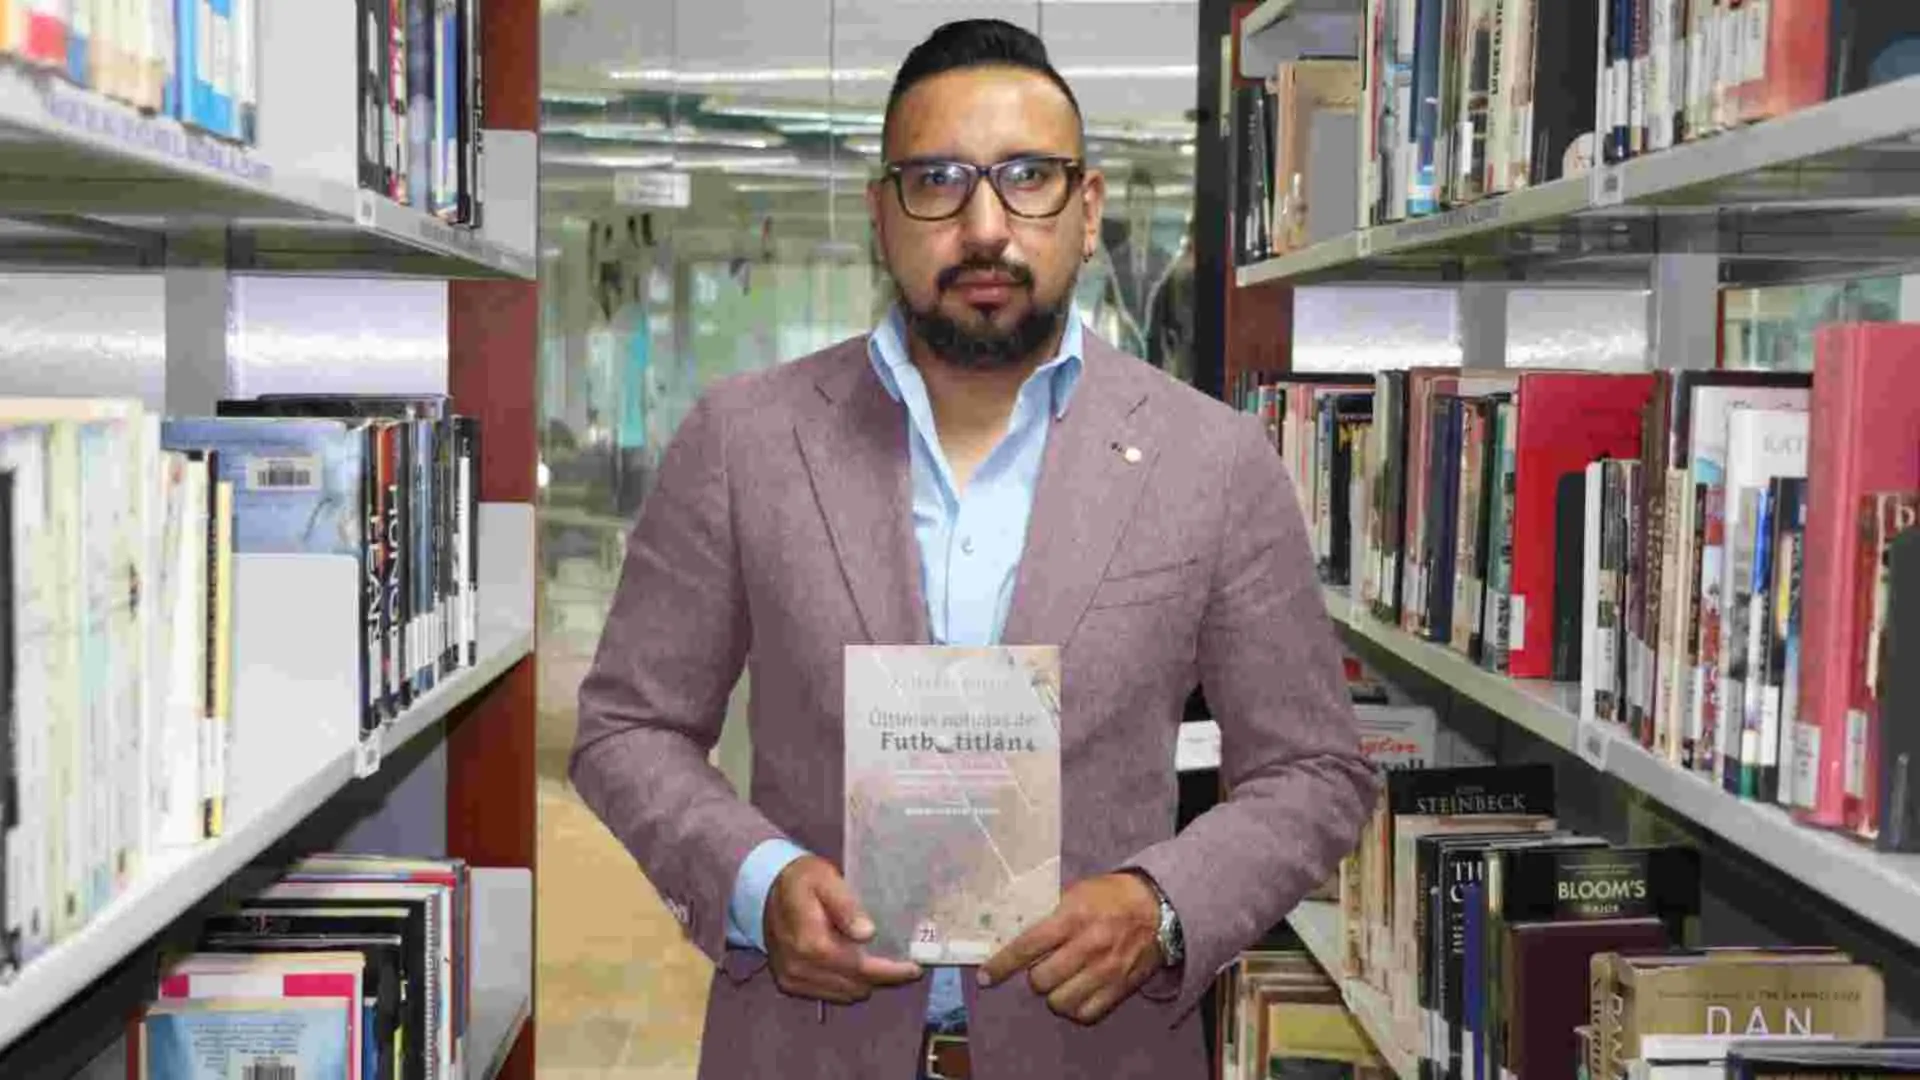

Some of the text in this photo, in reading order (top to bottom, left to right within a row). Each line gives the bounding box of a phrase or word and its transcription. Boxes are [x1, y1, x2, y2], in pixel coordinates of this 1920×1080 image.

[1416, 794, 1527, 813] STEINBECK
[1558, 879, 1646, 900] BLOOM'S
[1706, 1005, 1813, 1037] DAN
